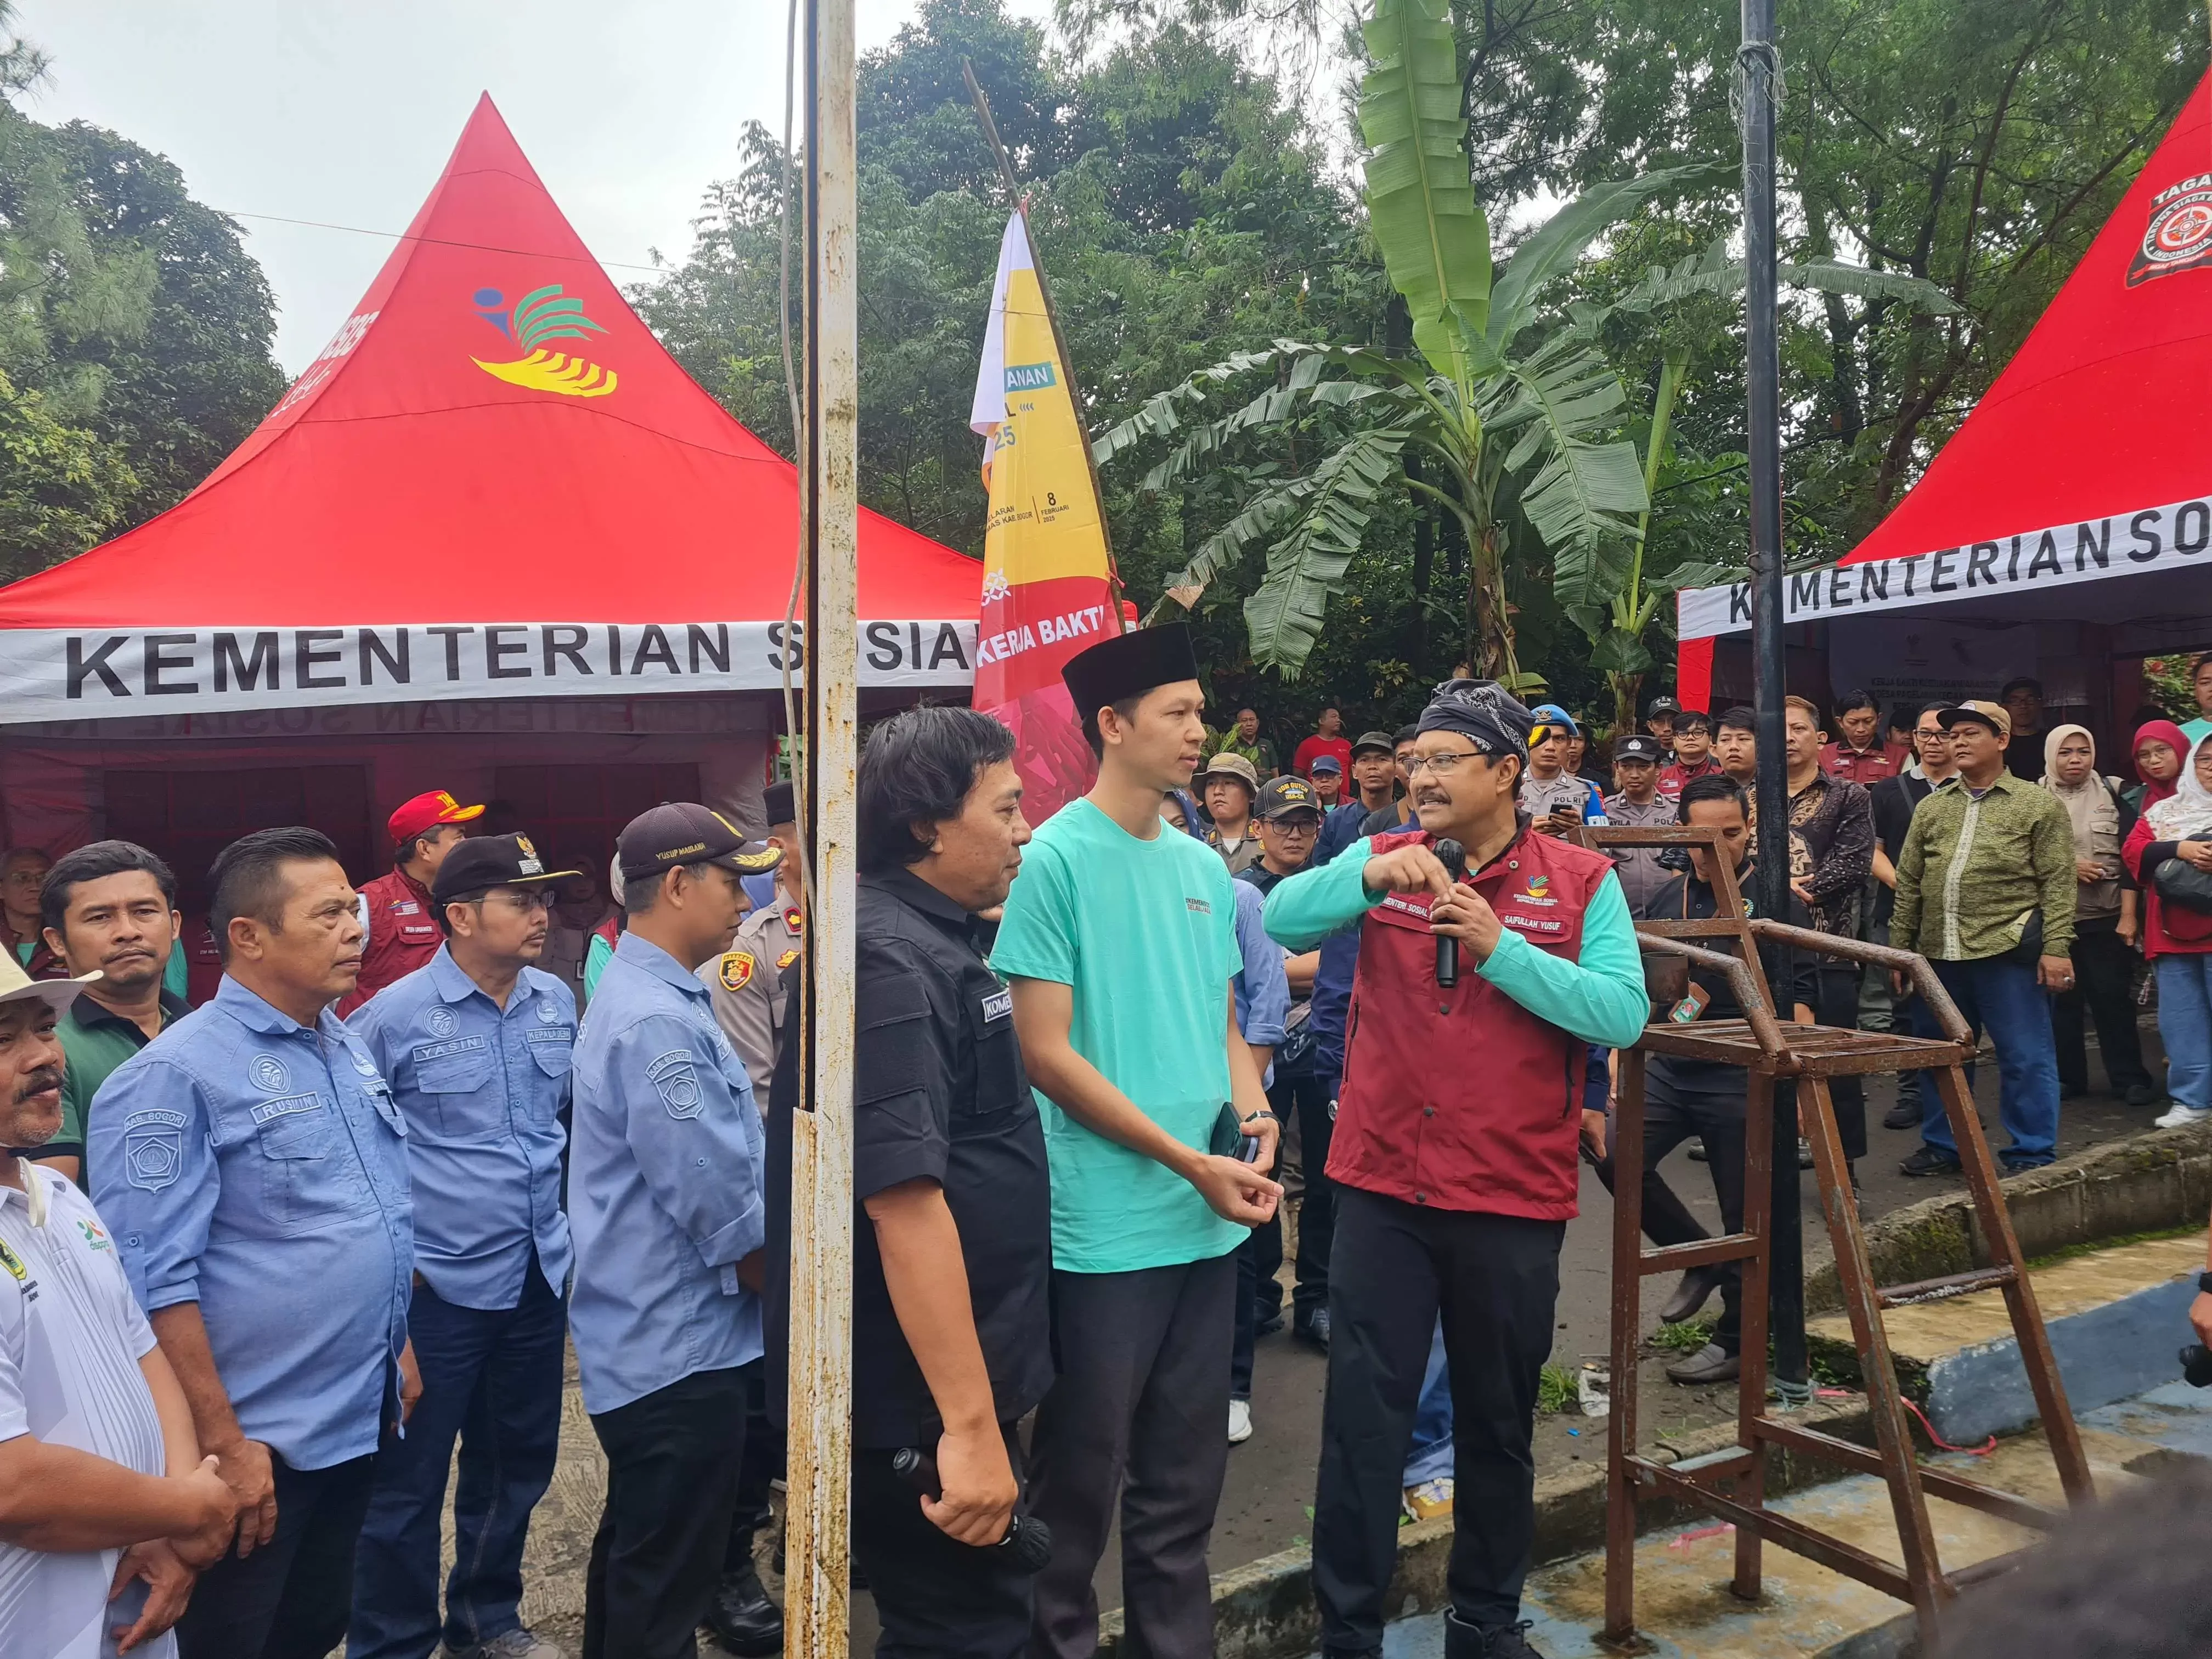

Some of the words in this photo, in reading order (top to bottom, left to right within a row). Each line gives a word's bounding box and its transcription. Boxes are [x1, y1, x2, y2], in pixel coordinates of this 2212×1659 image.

[2152, 238, 2212, 258] INDONESIA
[1047, 492, 1056, 506] 8
[1041, 505, 1069, 515] FEBRUARI
[1730, 517, 2110, 623] KMENTERIAN
[976, 625, 1036, 668] KERJA
[66, 623, 730, 699] KEMENTERIAN
[768, 622, 980, 671] SSIA
[1276, 783, 1290, 793] VON
[1290, 782, 1308, 793] DUTCH
[656, 849, 678, 860] YUSUP
[678, 842, 706, 855] MAULANA
[1383, 897, 1407, 910] MENTERI
[1408, 904, 1427, 917] SOSIAL
[1505, 915, 1538, 929] SAIFULLAH
[1538, 921, 1561, 931] YUSUF
[529, 1030, 556, 1040] KEPALA
[421, 1037, 477, 1058] YASIN
[664, 1052, 690, 1063] BOGOR
[148, 1113, 182, 1124] BOGOR
